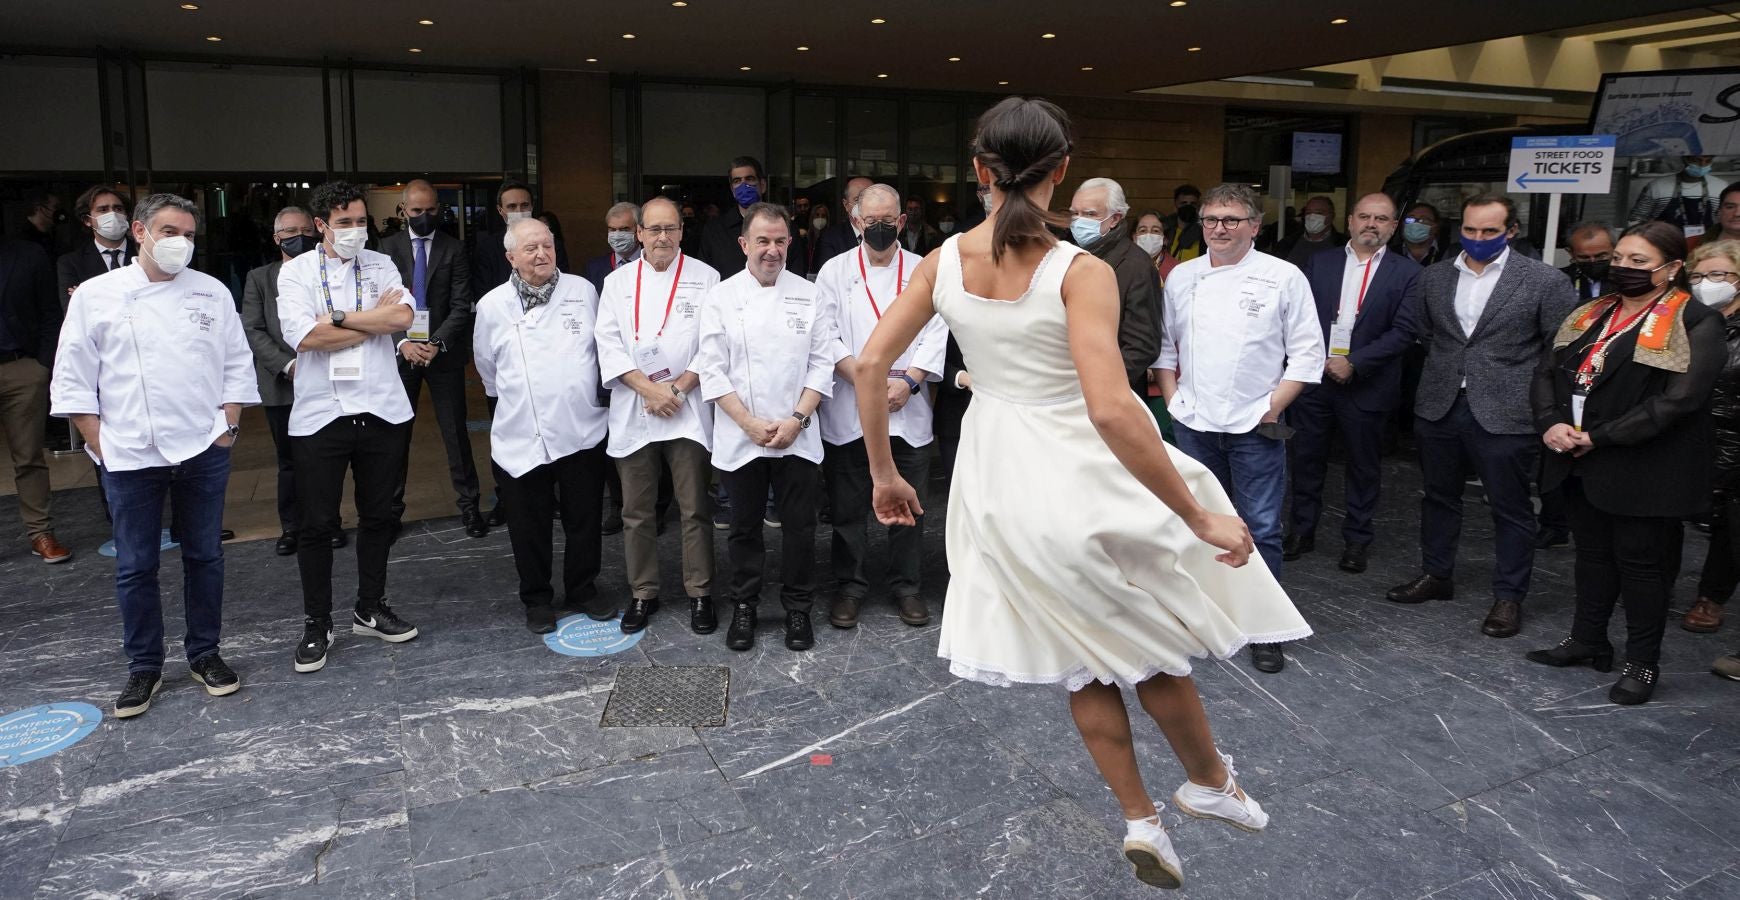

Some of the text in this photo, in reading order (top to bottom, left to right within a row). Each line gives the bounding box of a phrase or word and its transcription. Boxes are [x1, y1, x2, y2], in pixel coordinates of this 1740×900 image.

[1535, 151, 1603, 159] STREET FOOD
[1534, 162, 1602, 174] TICKETS
